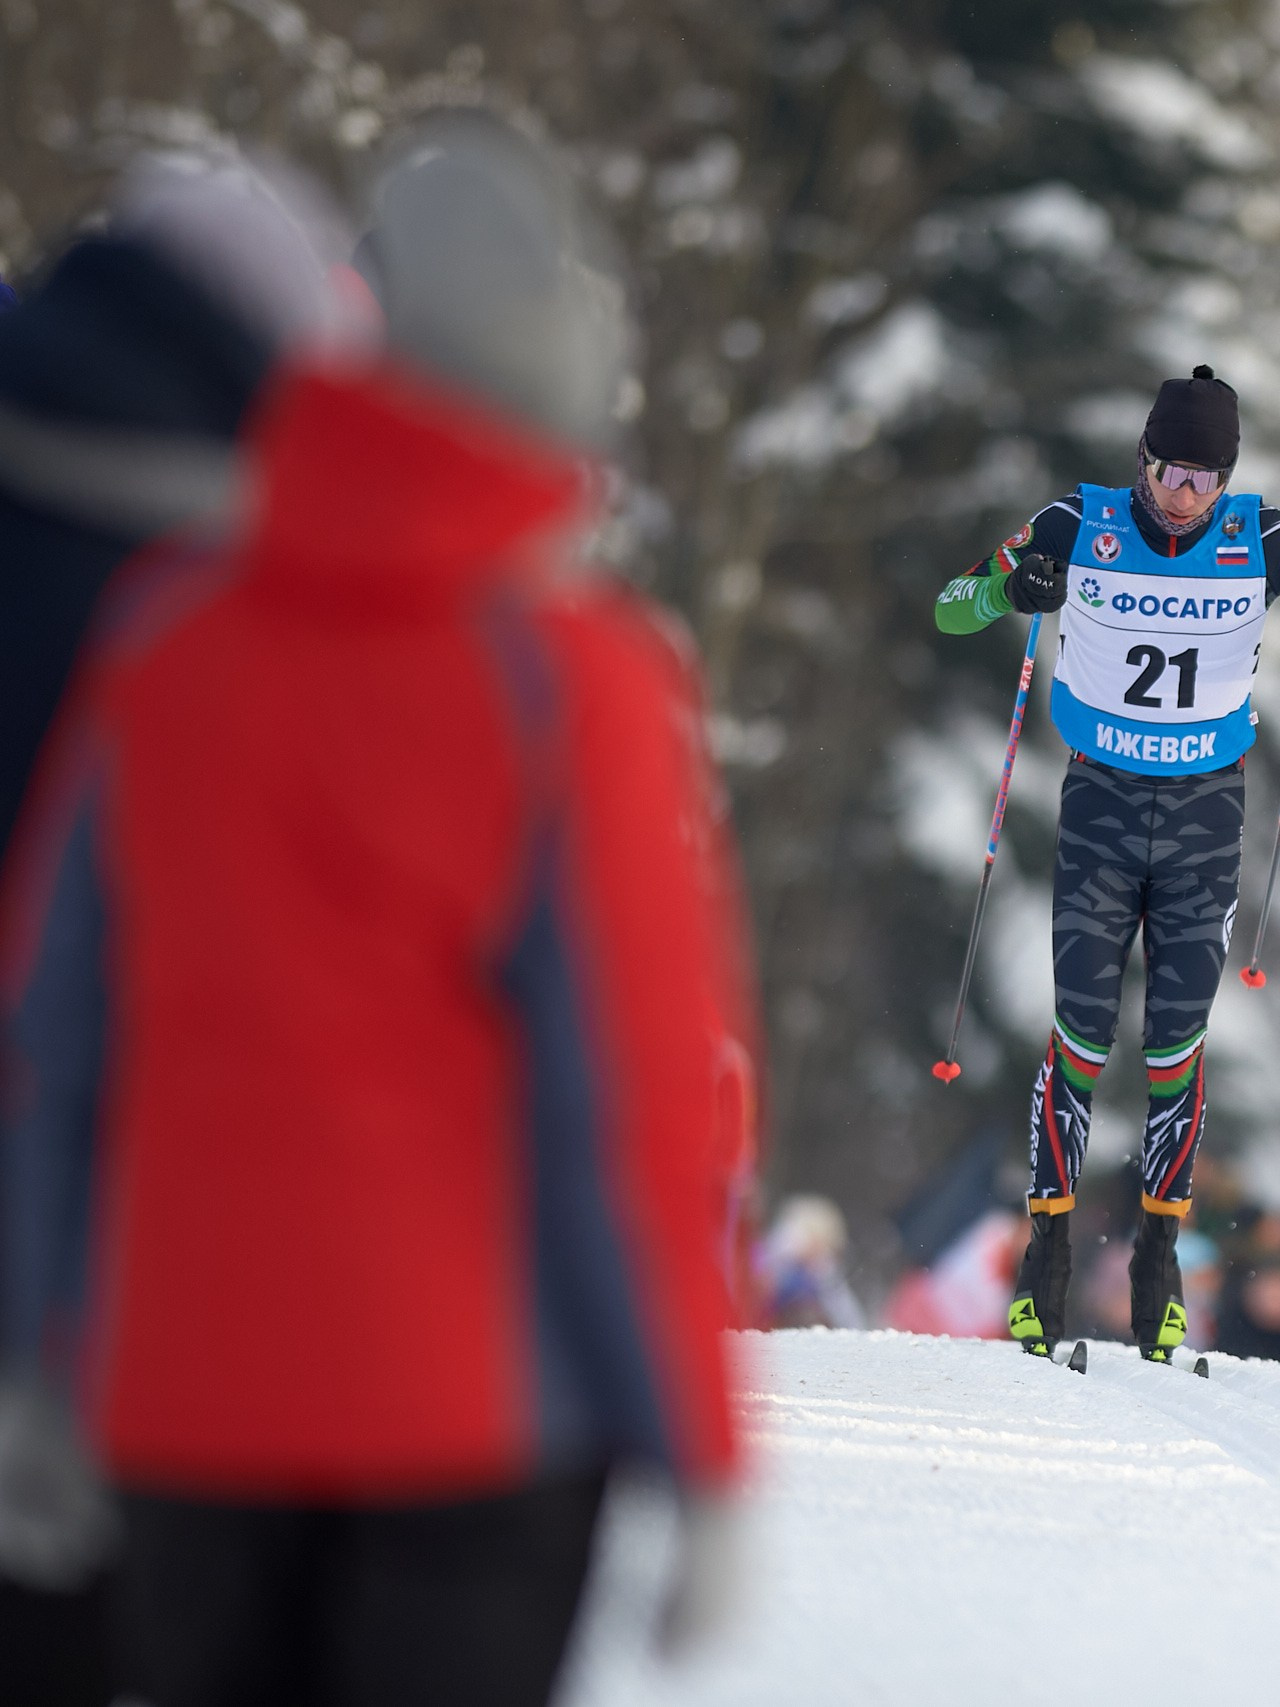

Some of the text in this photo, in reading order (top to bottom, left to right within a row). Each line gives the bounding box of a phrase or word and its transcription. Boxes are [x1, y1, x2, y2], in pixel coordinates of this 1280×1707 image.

[1111, 592, 1251, 620] ФОСАГРО
[1123, 644, 1200, 709] 21
[1096, 722, 1217, 763] ИЖЕВСК
